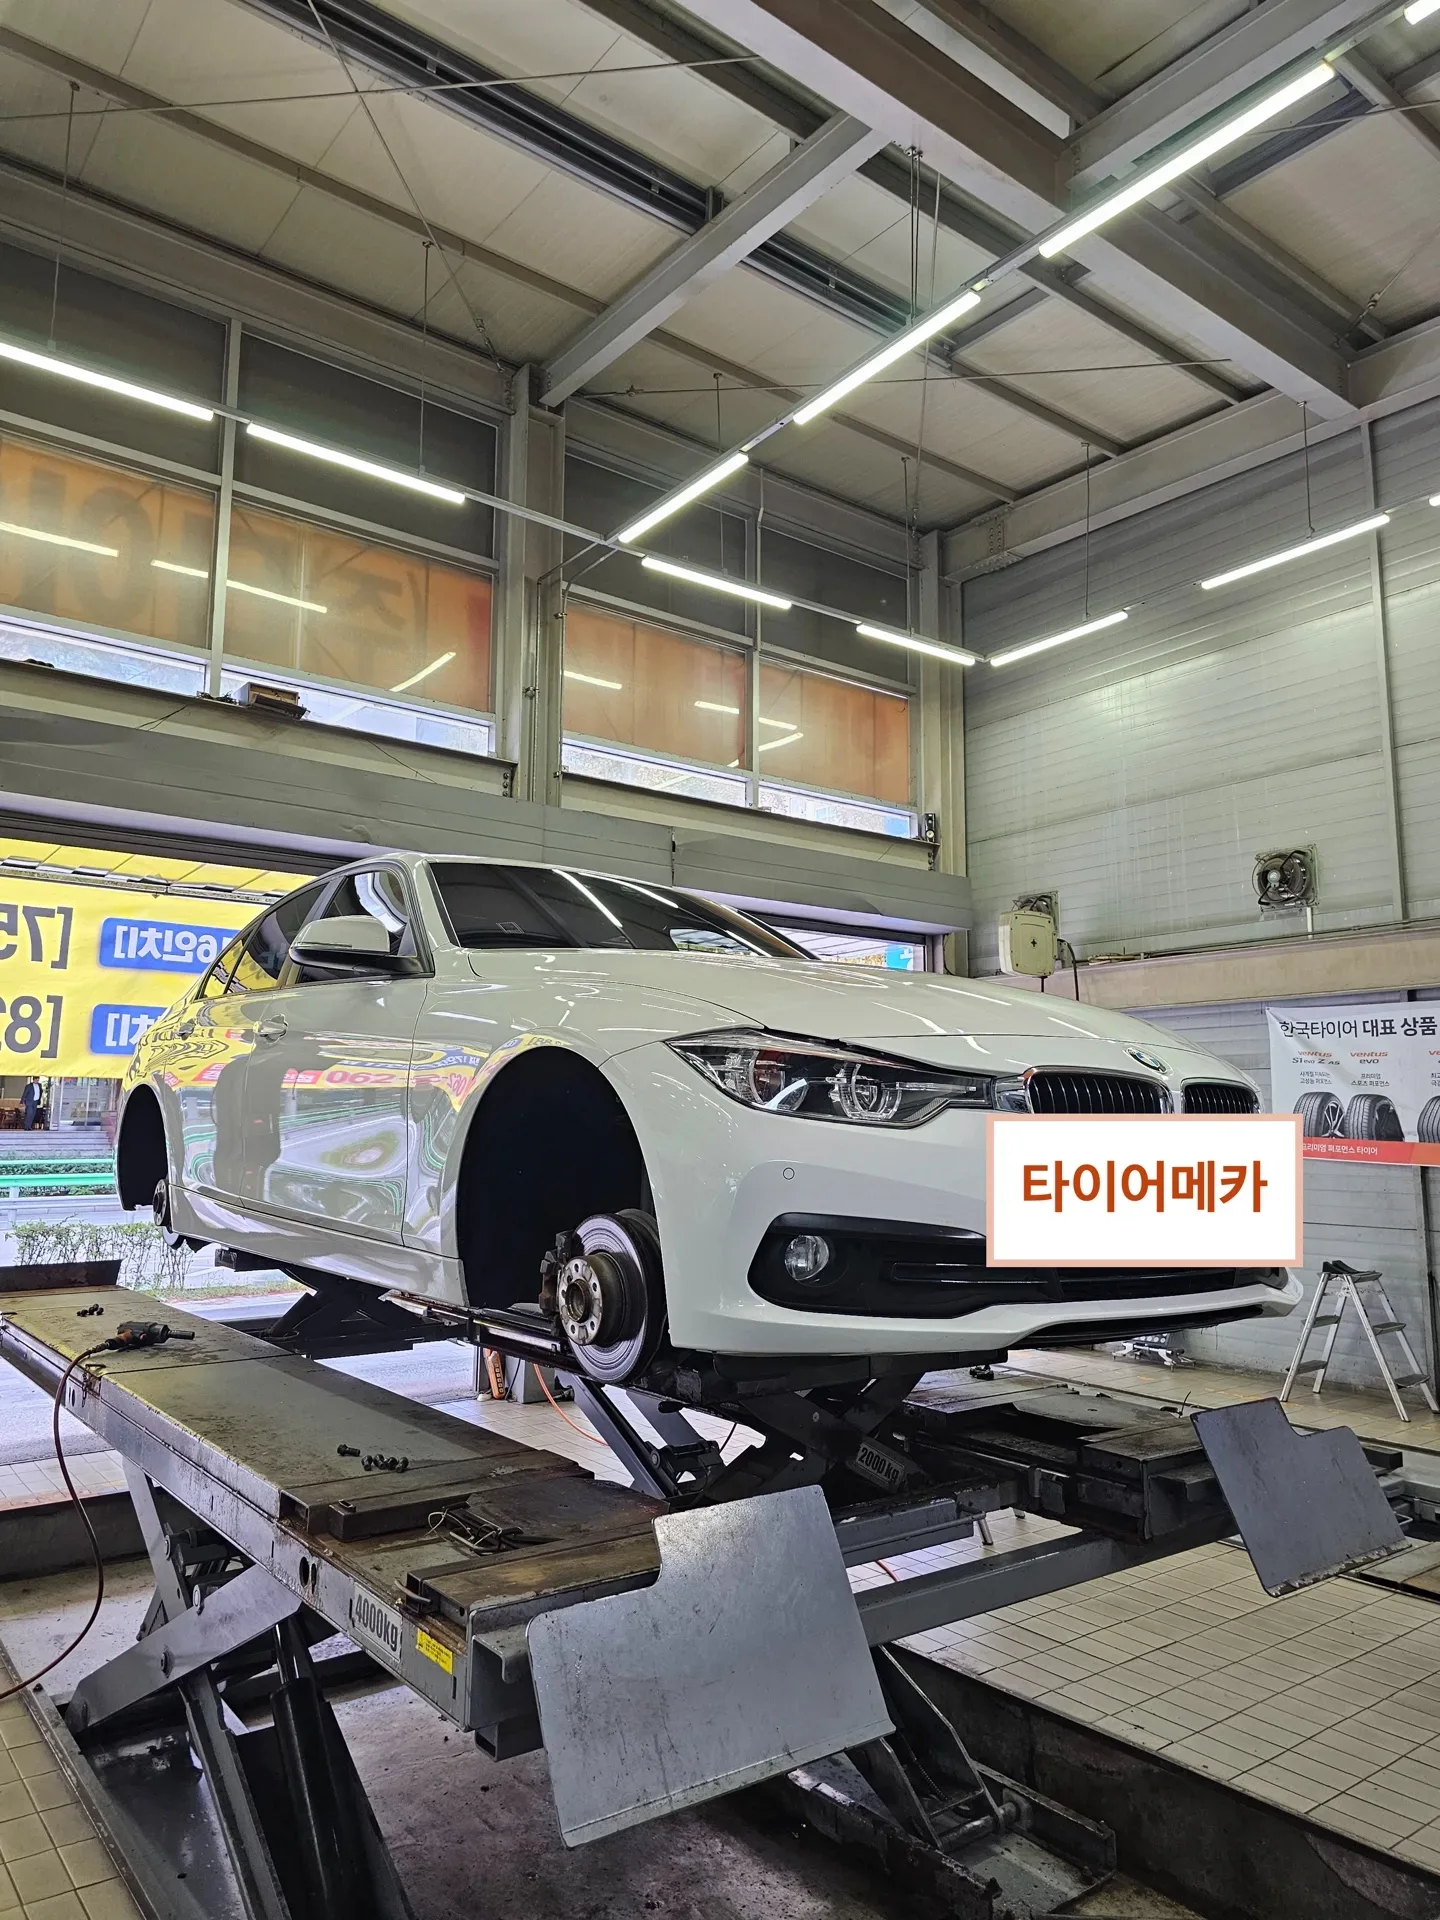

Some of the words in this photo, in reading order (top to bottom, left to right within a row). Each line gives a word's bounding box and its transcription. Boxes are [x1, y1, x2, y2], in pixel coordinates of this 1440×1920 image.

[1279, 1020, 1358, 1039] 한국타이어
[1363, 1019, 1397, 1037] 대표
[1401, 1016, 1437, 1036] 상품
[1328, 1144, 1355, 1153] 퍼포먼스
[1357, 1146, 1378, 1155] 타이어
[355, 1593, 398, 1652] 4000kg
